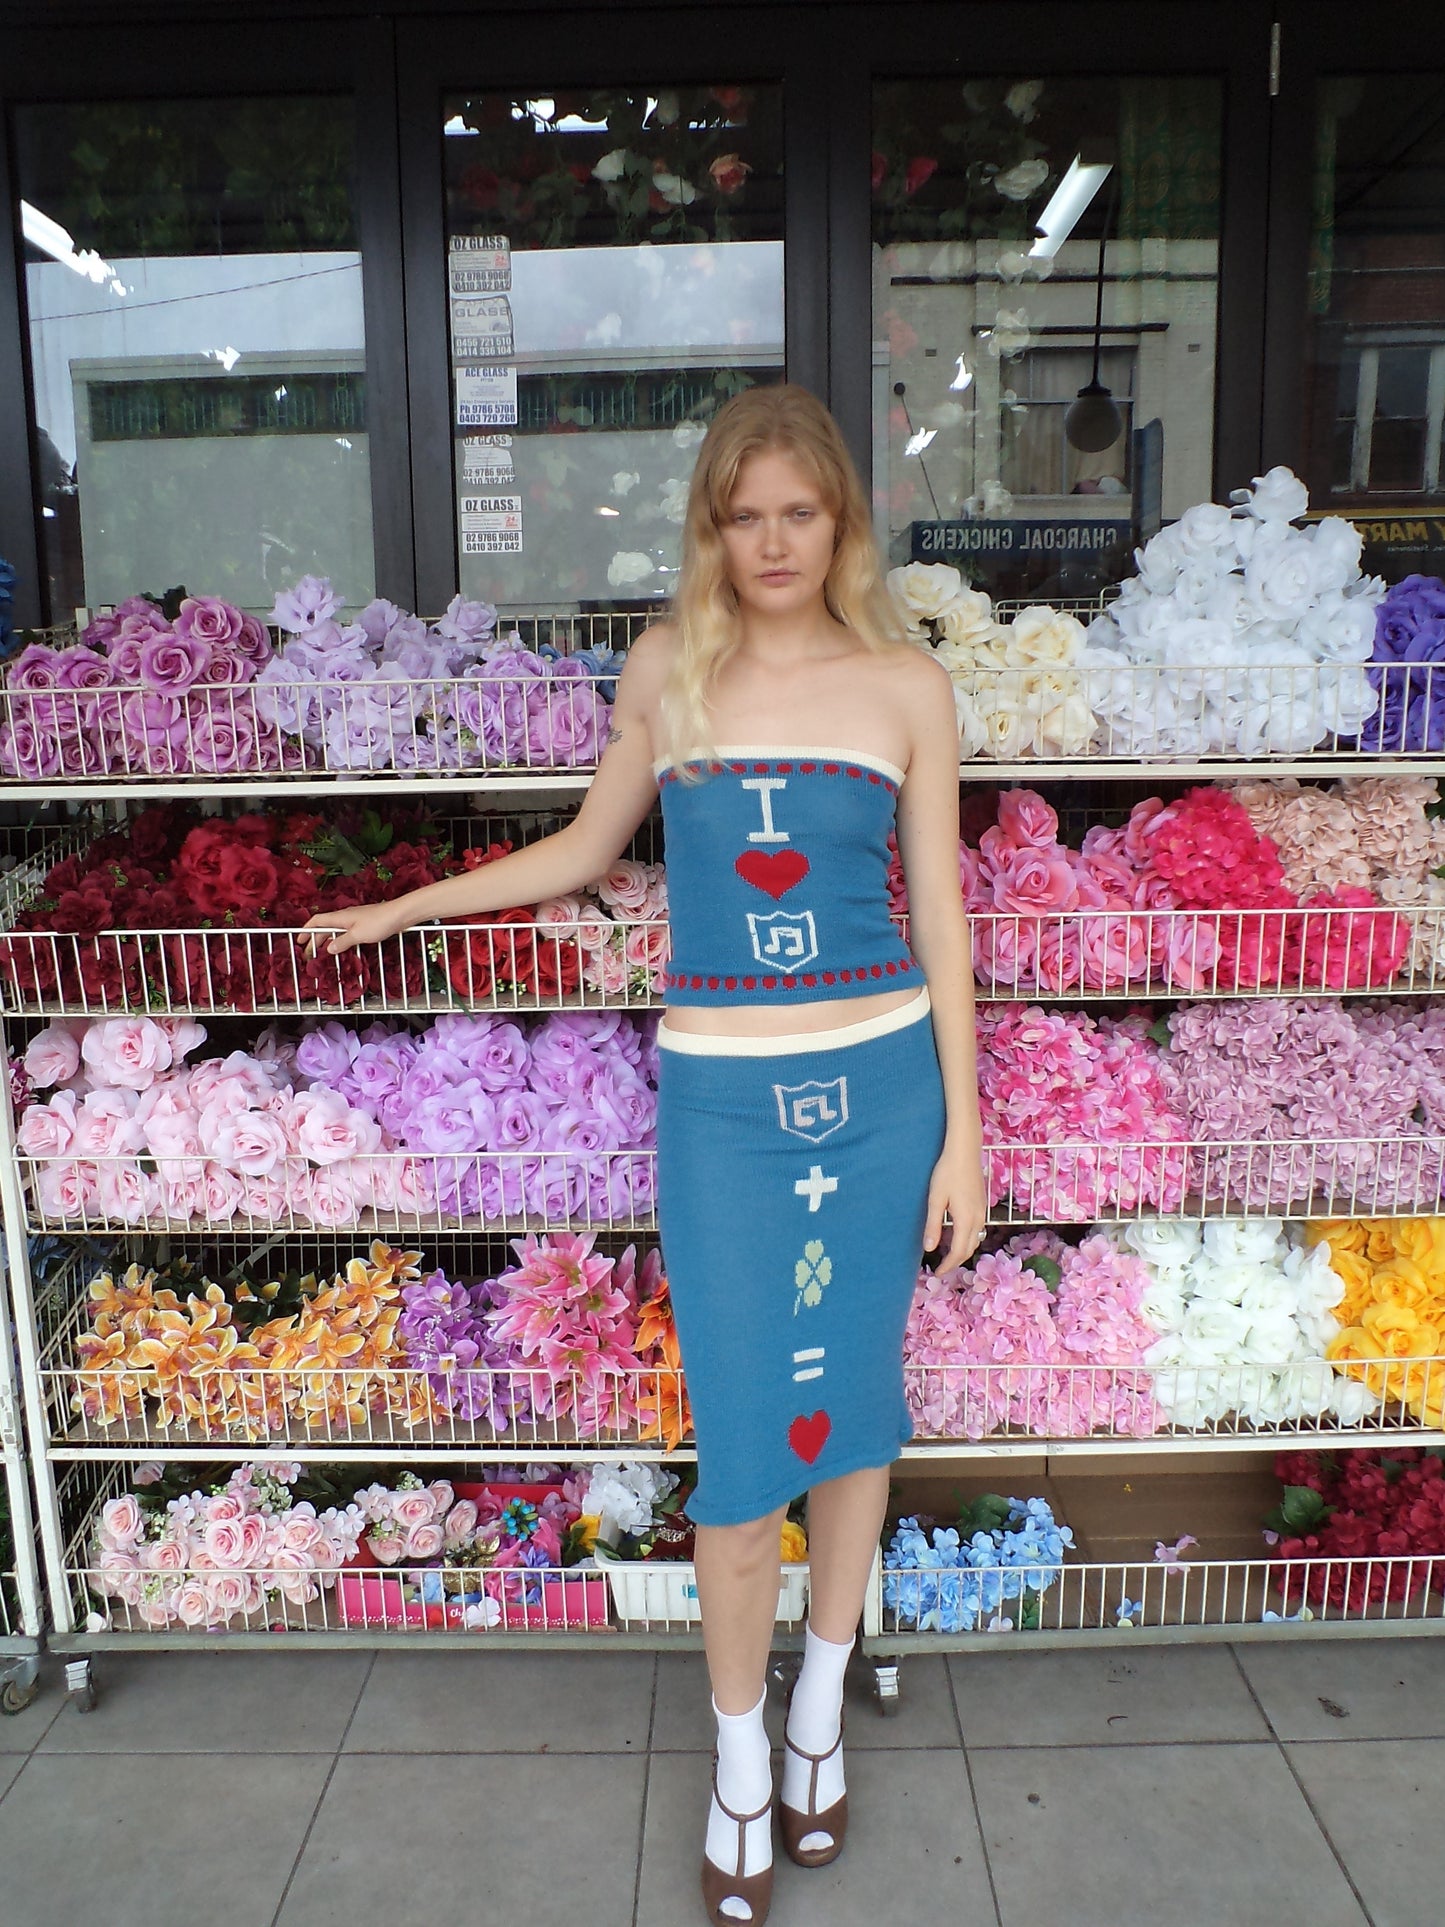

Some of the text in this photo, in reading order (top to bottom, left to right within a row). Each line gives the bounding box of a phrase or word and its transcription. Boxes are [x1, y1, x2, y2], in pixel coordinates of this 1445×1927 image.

[454, 236, 503, 250] OZ GLASS
[456, 347, 478, 356] 0414
[497, 345, 512, 355] 104
[465, 367, 509, 377] ACE GLASS
[460, 404, 470, 413] Ph
[472, 404, 493, 413] 9786
[459, 413, 516, 423] 0403 720 260
[478, 435, 507, 446] GLASS
[465, 499, 479, 511] OZ
[480, 498, 514, 511] GLASS
[466, 532, 519, 542] 02 9786 9068
[466, 542, 520, 551] 0410 392 042
[742, 777, 791, 843] I
